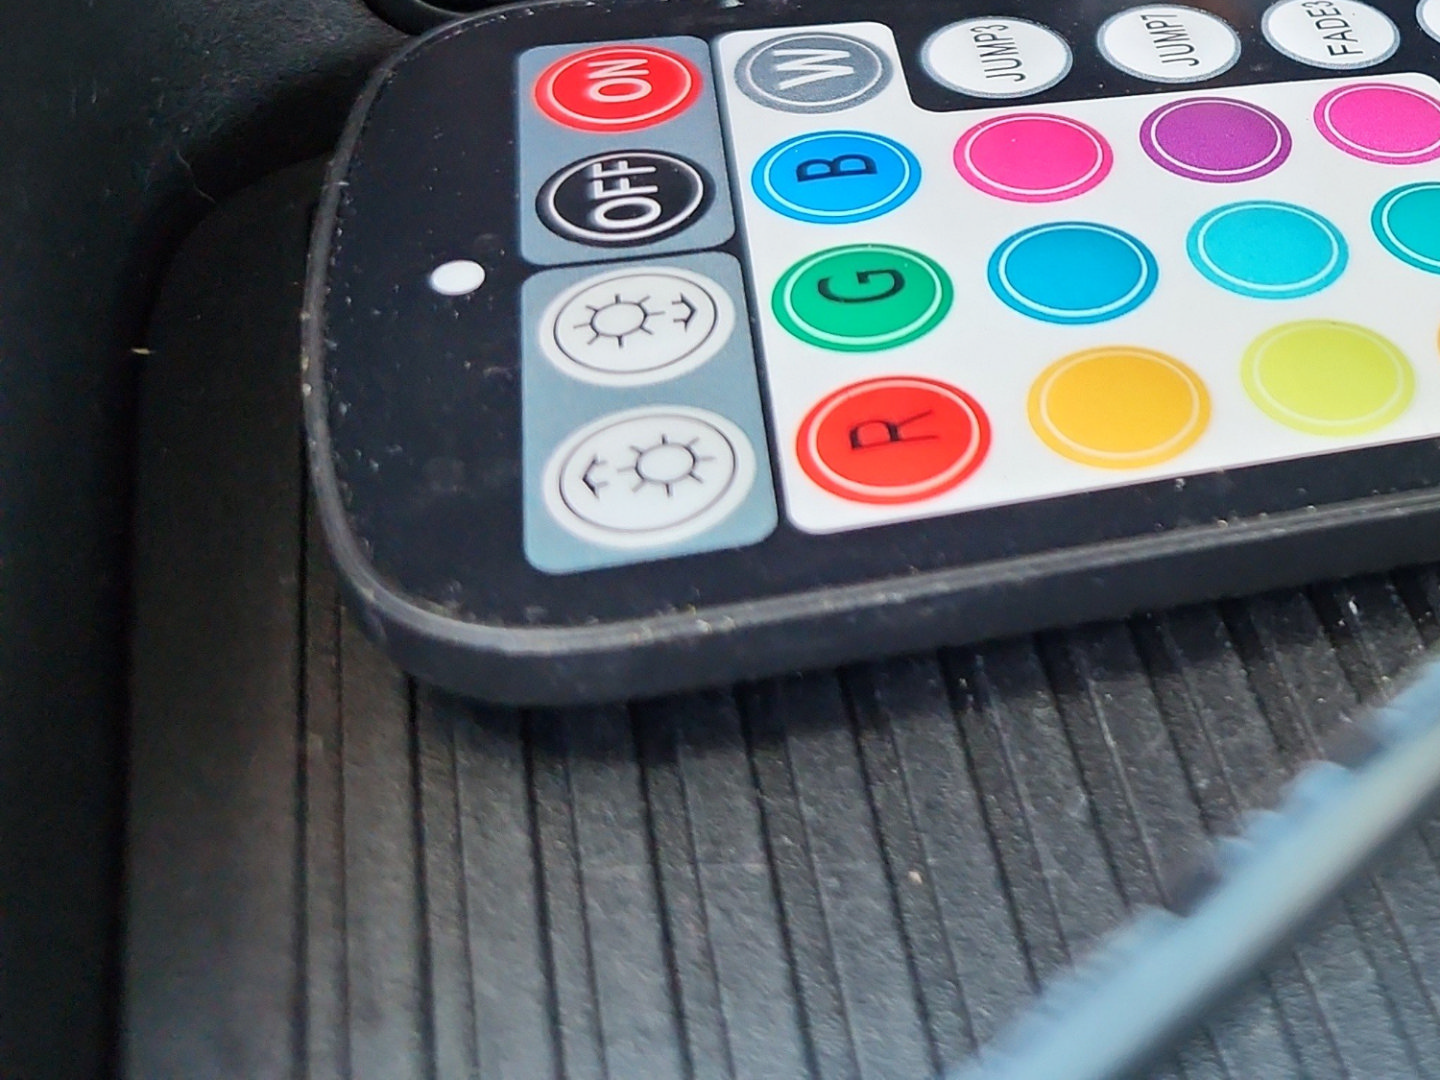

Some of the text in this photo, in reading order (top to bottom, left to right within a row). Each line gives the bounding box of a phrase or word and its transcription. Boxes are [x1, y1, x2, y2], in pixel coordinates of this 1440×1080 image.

[1309, 0, 1363, 57] FADE3
[773, 48, 855, 90] W
[970, 23, 1026, 83] JUMP3
[589, 58, 652, 103] ON
[796, 153, 877, 183] B
[592, 160, 662, 228] OFF
[817, 268, 906, 304] G
[848, 409, 939, 450] R
